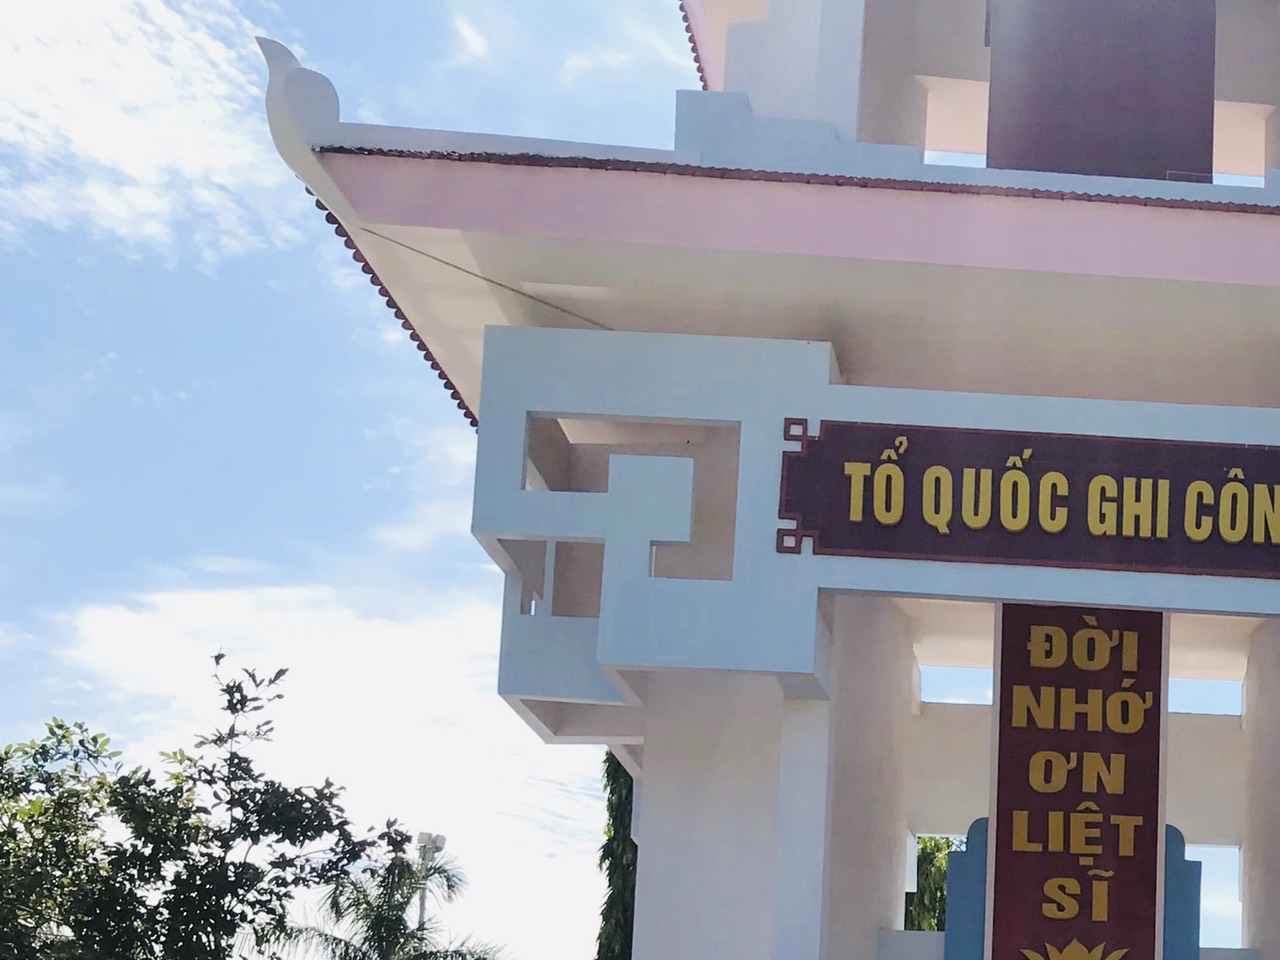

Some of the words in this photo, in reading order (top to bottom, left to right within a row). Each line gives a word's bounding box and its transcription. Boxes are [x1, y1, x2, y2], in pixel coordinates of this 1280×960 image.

[844, 436, 908, 526] TỔ
[921, 448, 1069, 535] QUỐC
[1087, 474, 1170, 539] GHI
[1027, 615, 1139, 672] ĐỜI
[1012, 678, 1153, 734] NHỚ
[1028, 751, 1126, 795] ƠN
[1012, 801, 1144, 866] LIỆT
[1041, 869, 1115, 922] SĨ
